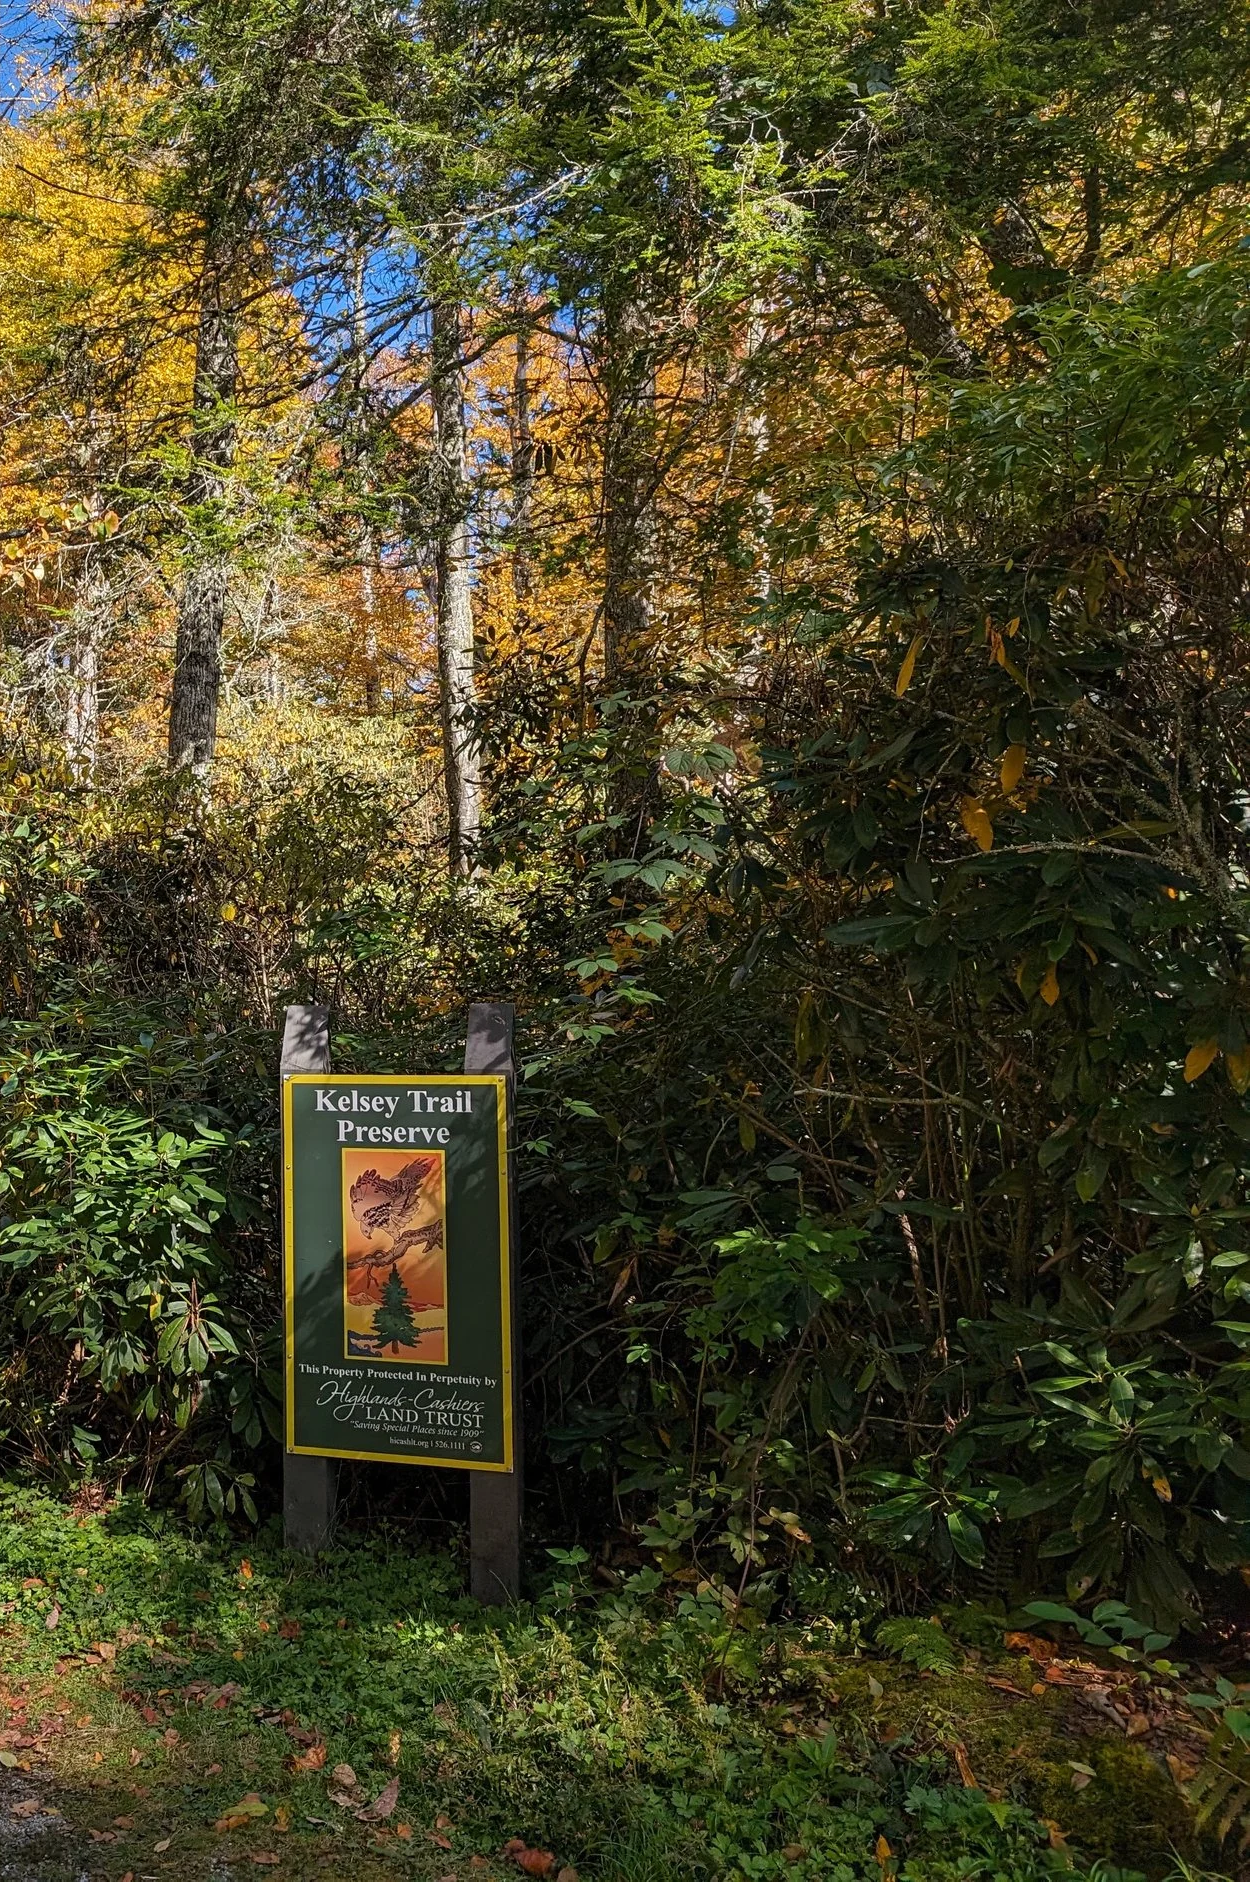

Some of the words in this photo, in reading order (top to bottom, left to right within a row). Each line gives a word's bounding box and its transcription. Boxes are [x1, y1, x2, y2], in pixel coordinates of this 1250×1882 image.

[314, 1089, 400, 1119] Kelsey
[407, 1090, 473, 1113] Trail
[336, 1119, 451, 1144] Preserve
[299, 1363, 320, 1374] This
[322, 1365, 364, 1379] Property
[367, 1368, 413, 1381] Protected
[416, 1371, 427, 1382] In
[430, 1372, 481, 1388] Perpetuity
[484, 1376, 497, 1388] by
[316, 1380, 485, 1421] Highlands-Cashiers
[365, 1406, 419, 1423] LAND
[424, 1410, 484, 1428] TRUST
[382, 1422, 410, 1433] Special
[411, 1424, 436, 1435] Places
[437, 1427, 458, 1436] since
